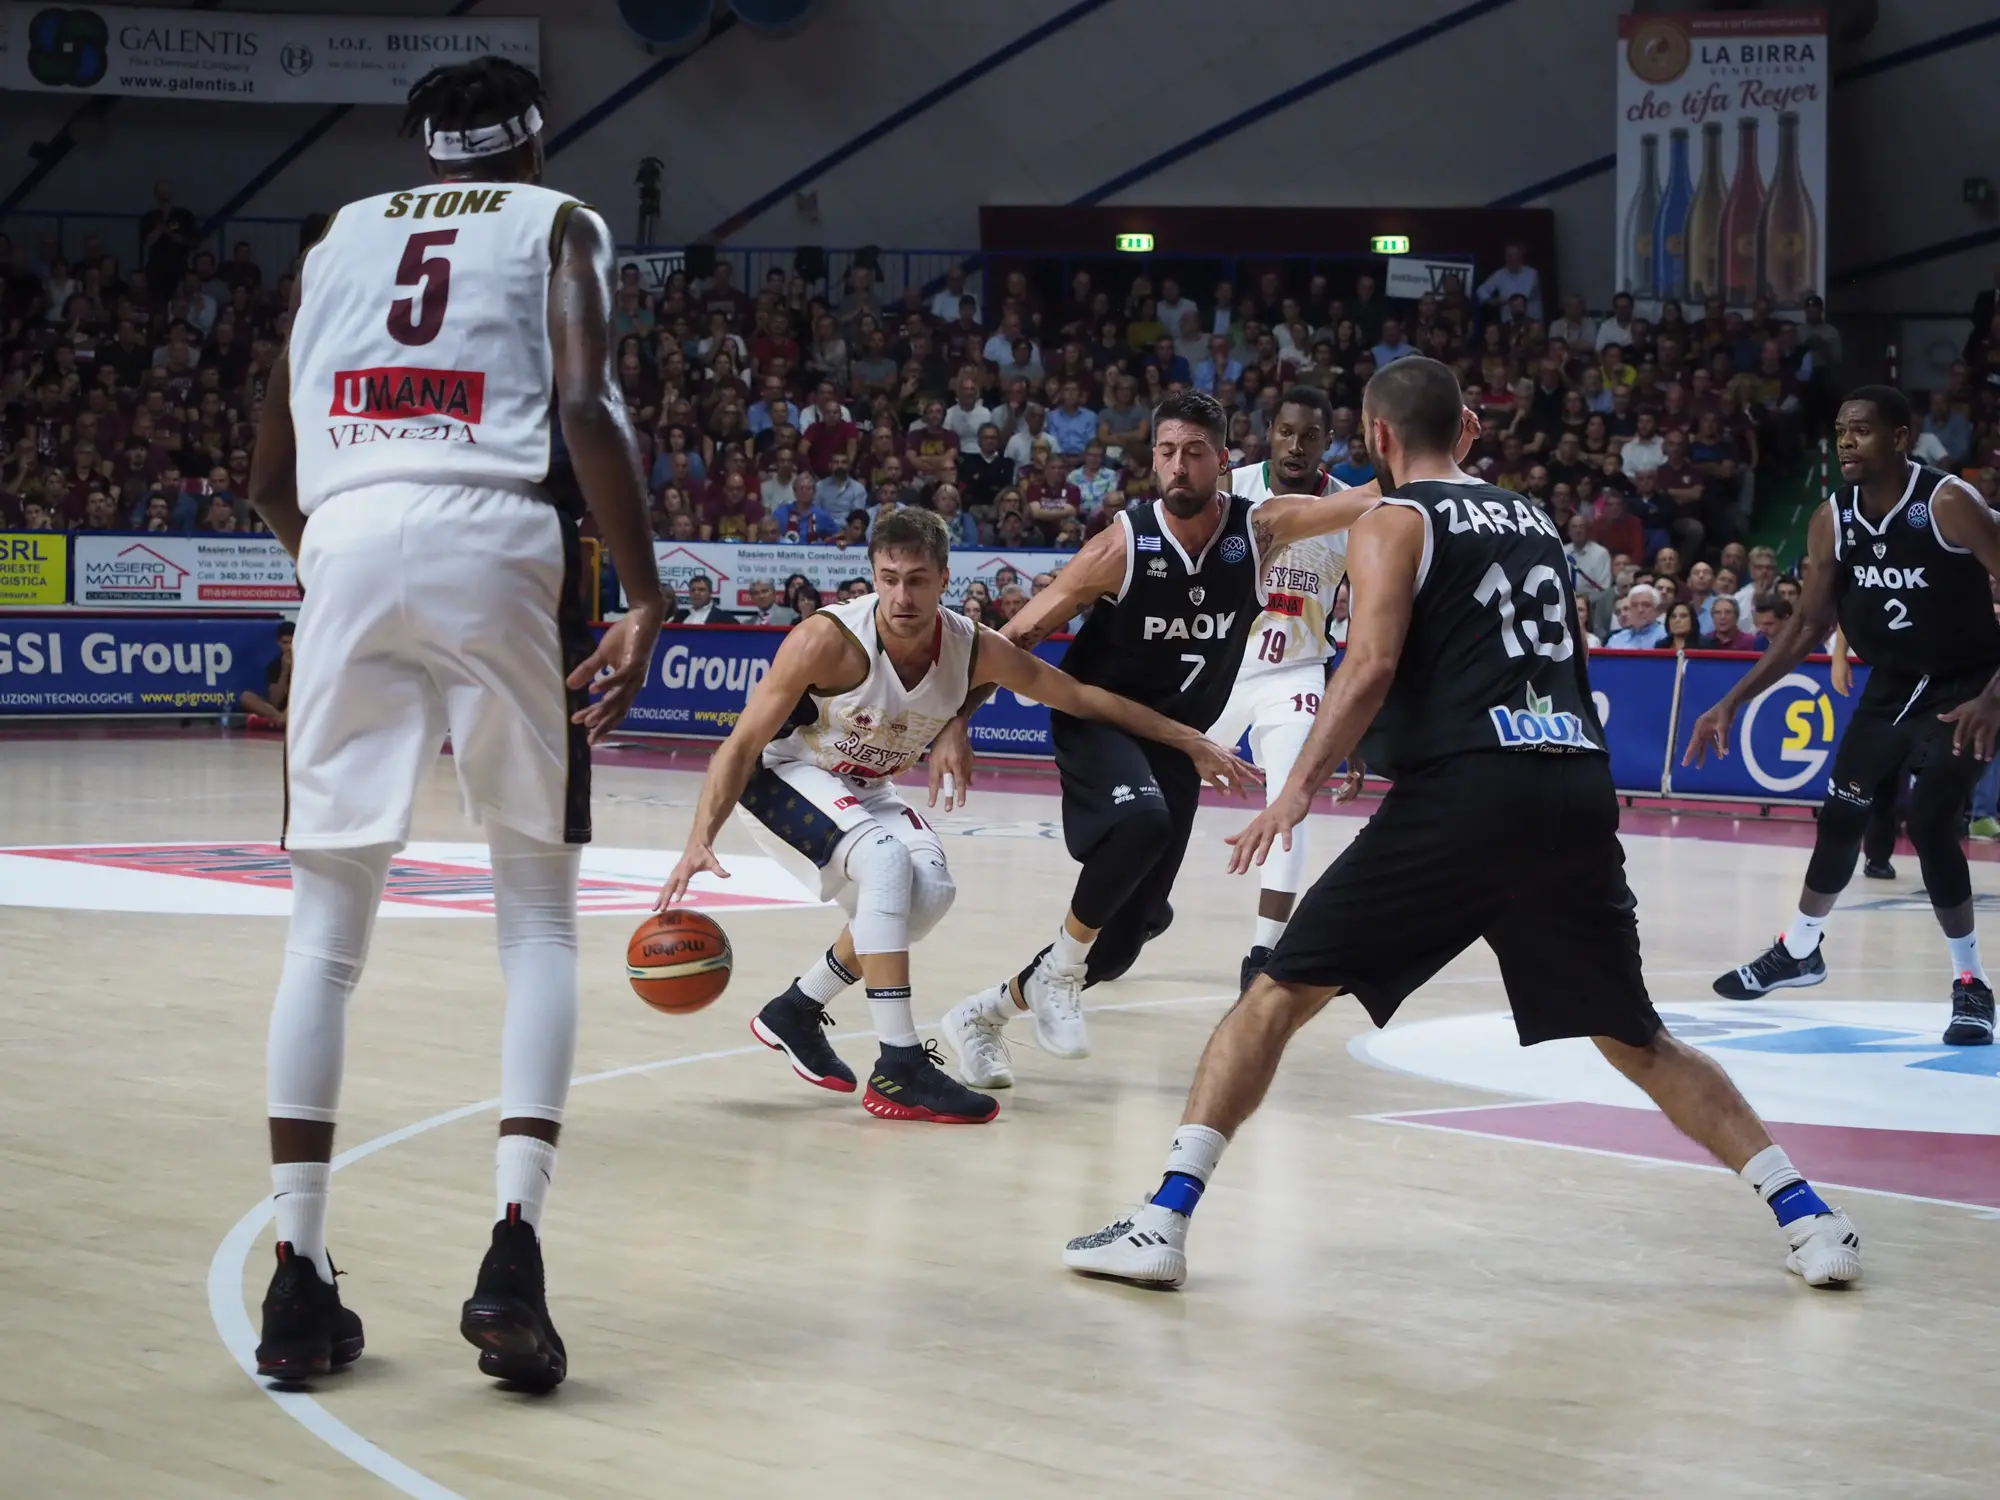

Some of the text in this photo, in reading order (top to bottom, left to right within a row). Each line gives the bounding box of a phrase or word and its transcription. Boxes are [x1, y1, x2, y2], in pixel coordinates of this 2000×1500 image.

[119, 25, 259, 56] GALENTIS
[387, 34, 491, 52] BUSOLIN
[1702, 44, 1816, 63] LA BIRRA
[1709, 64, 1807, 77] VENEZIANA
[119, 75, 255, 93] www.galentis.it
[1626, 78, 1820, 124] che tifa Reyer
[384, 190, 512, 219] STONE
[386, 228, 459, 346] 5
[343, 374, 470, 416] UMANA
[327, 424, 477, 450] VENEZIA
[0, 539, 48, 561] SRL
[198, 545, 235, 555] Masiero
[238, 545, 266, 555] Mattia
[738, 550, 774, 559] Masiero
[777, 551, 805, 560] Mattia
[808, 551, 860, 561] Costruzioni
[86, 562, 165, 573] MASIERO
[827, 566, 846, 575] Valli
[849, 567, 858, 576] di
[1853, 565, 1930, 590] PAOK
[86, 575, 151, 585] MATTIA
[1473, 562, 1574, 662] 13
[1884, 598, 1913, 630] 2
[1143, 610, 1236, 640] PAOK
[1258, 628, 1286, 664] 19
[80, 632, 233, 686] Group
[661, 645, 771, 705] Group
[1180, 653, 1206, 692] 7
[0, 690, 235, 706] UZIONI TECNOLOGICHE www.gsigroup.it
[1290, 693, 1320, 716] 19
[628, 707, 690, 721] TECNOLOGICHE
[974, 726, 1048, 742] TECNOLOGICHE
[643, 940, 705, 957] molten
[828, 958, 854, 984] adidas
[873, 989, 909, 998] adidas
